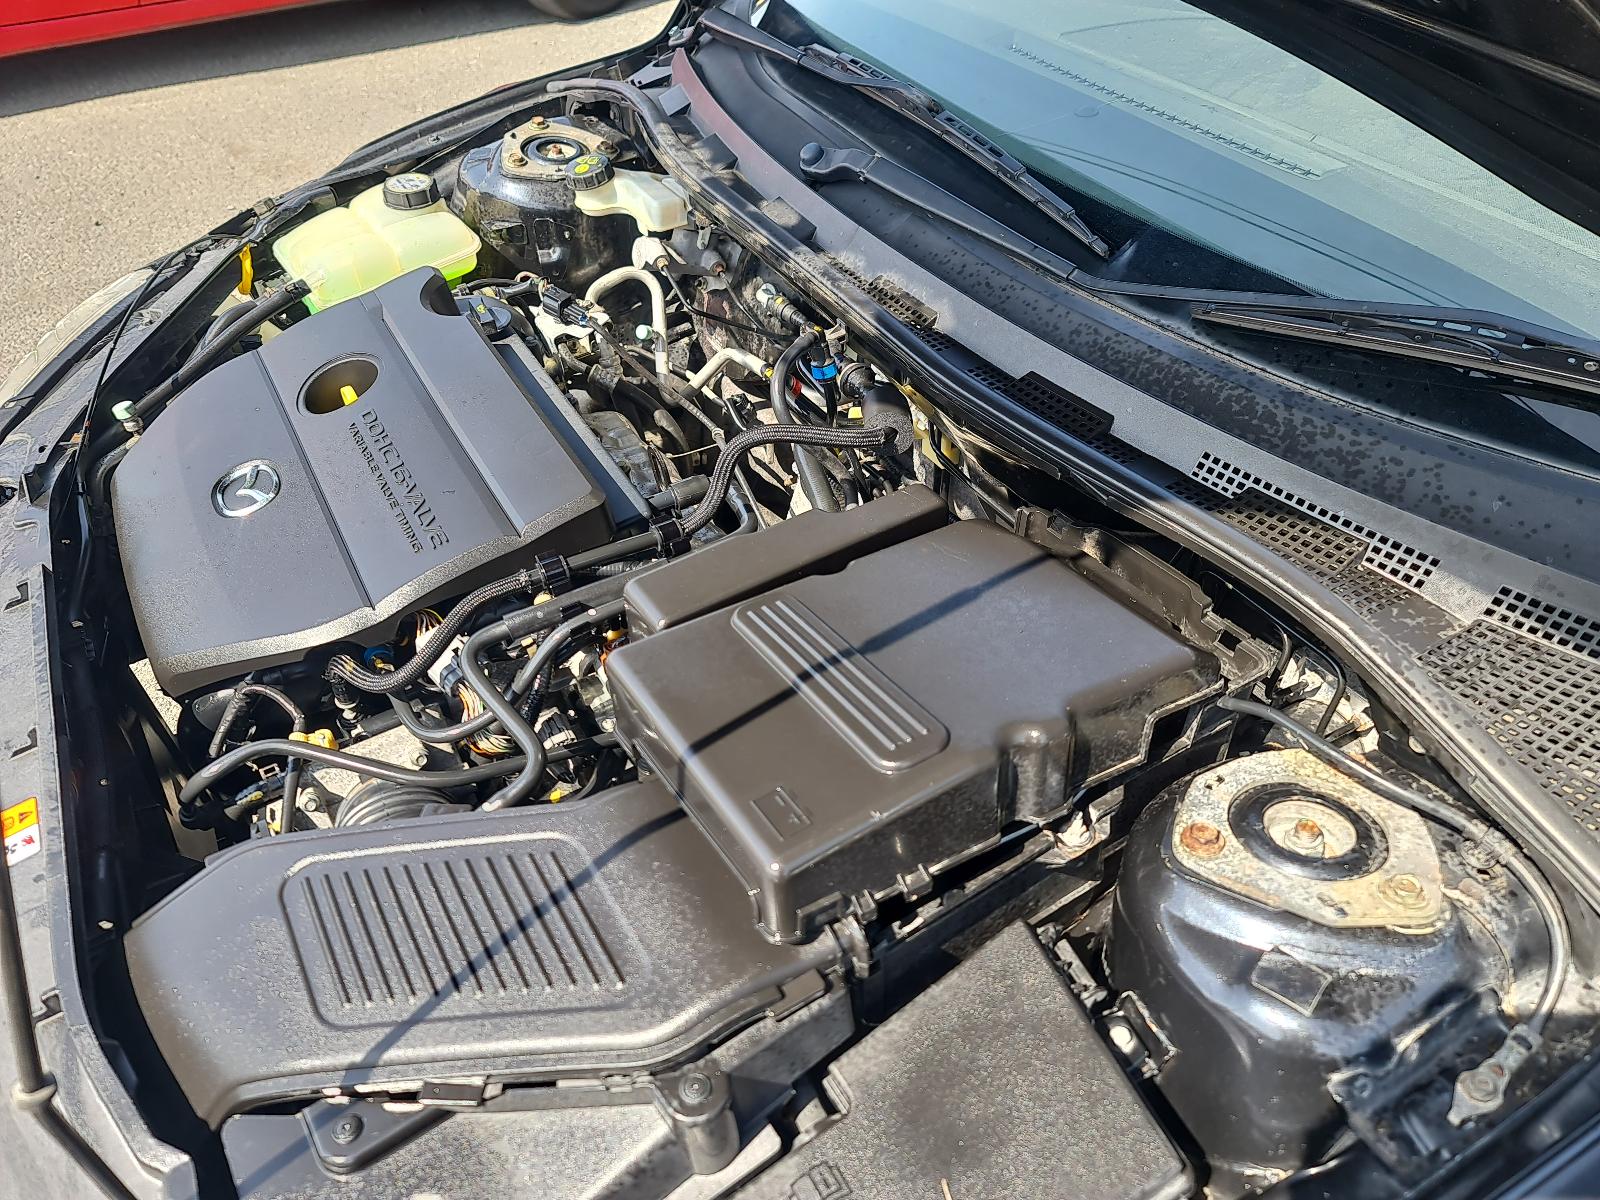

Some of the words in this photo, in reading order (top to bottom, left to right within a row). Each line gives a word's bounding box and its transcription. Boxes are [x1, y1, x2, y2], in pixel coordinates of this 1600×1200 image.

[362, 408, 400, 464] DOHC
[349, 422, 379, 474] VARIABLE
[376, 473, 400, 510] VALVE
[395, 508, 424, 553] TIMING
